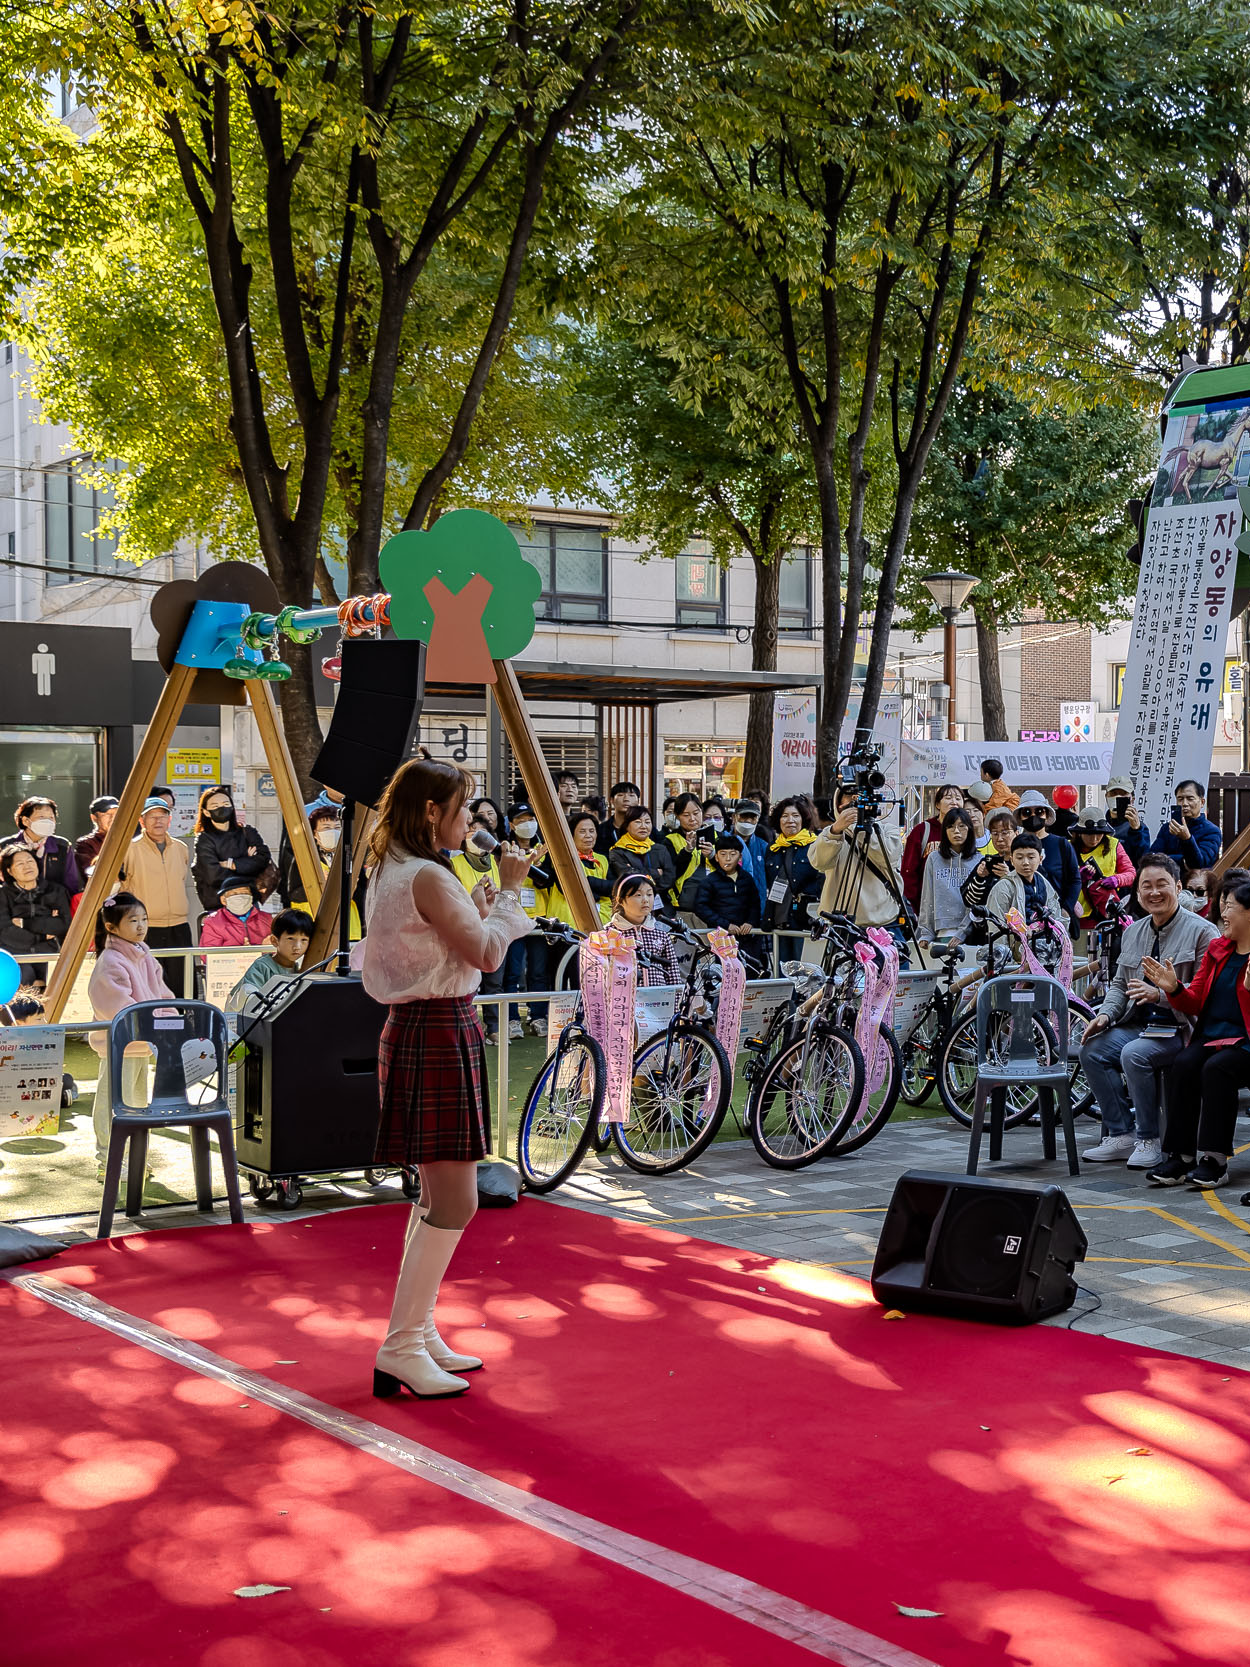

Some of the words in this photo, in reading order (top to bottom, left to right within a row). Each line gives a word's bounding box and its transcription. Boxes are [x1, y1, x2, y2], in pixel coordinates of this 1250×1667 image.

[1143, 519, 1161, 585] 자마장이라
[1159, 518, 1173, 557] 난다고
[1197, 515, 1210, 556] 자양동
[1156, 561, 1167, 588] 하여
[1163, 563, 1179, 617] 국가에서
[1173, 562, 1191, 629] 자양동으로
[1190, 558, 1204, 599] 동명은
[1202, 510, 1238, 643] 자양동의
[1135, 587, 1151, 649] 칭하였다.
[1145, 607, 1161, 660] 지역에서
[1161, 620, 1171, 634] 말
[1182, 603, 1199, 656] 조선시대
[1167, 632, 1181, 674] 전음된
[1163, 677, 1175, 703] 데서
[1190, 661, 1215, 731] 유래
[1169, 716, 1183, 758] 암말을
[1142, 738, 1155, 779] 기르면
[1164, 760, 1176, 788] 길러
